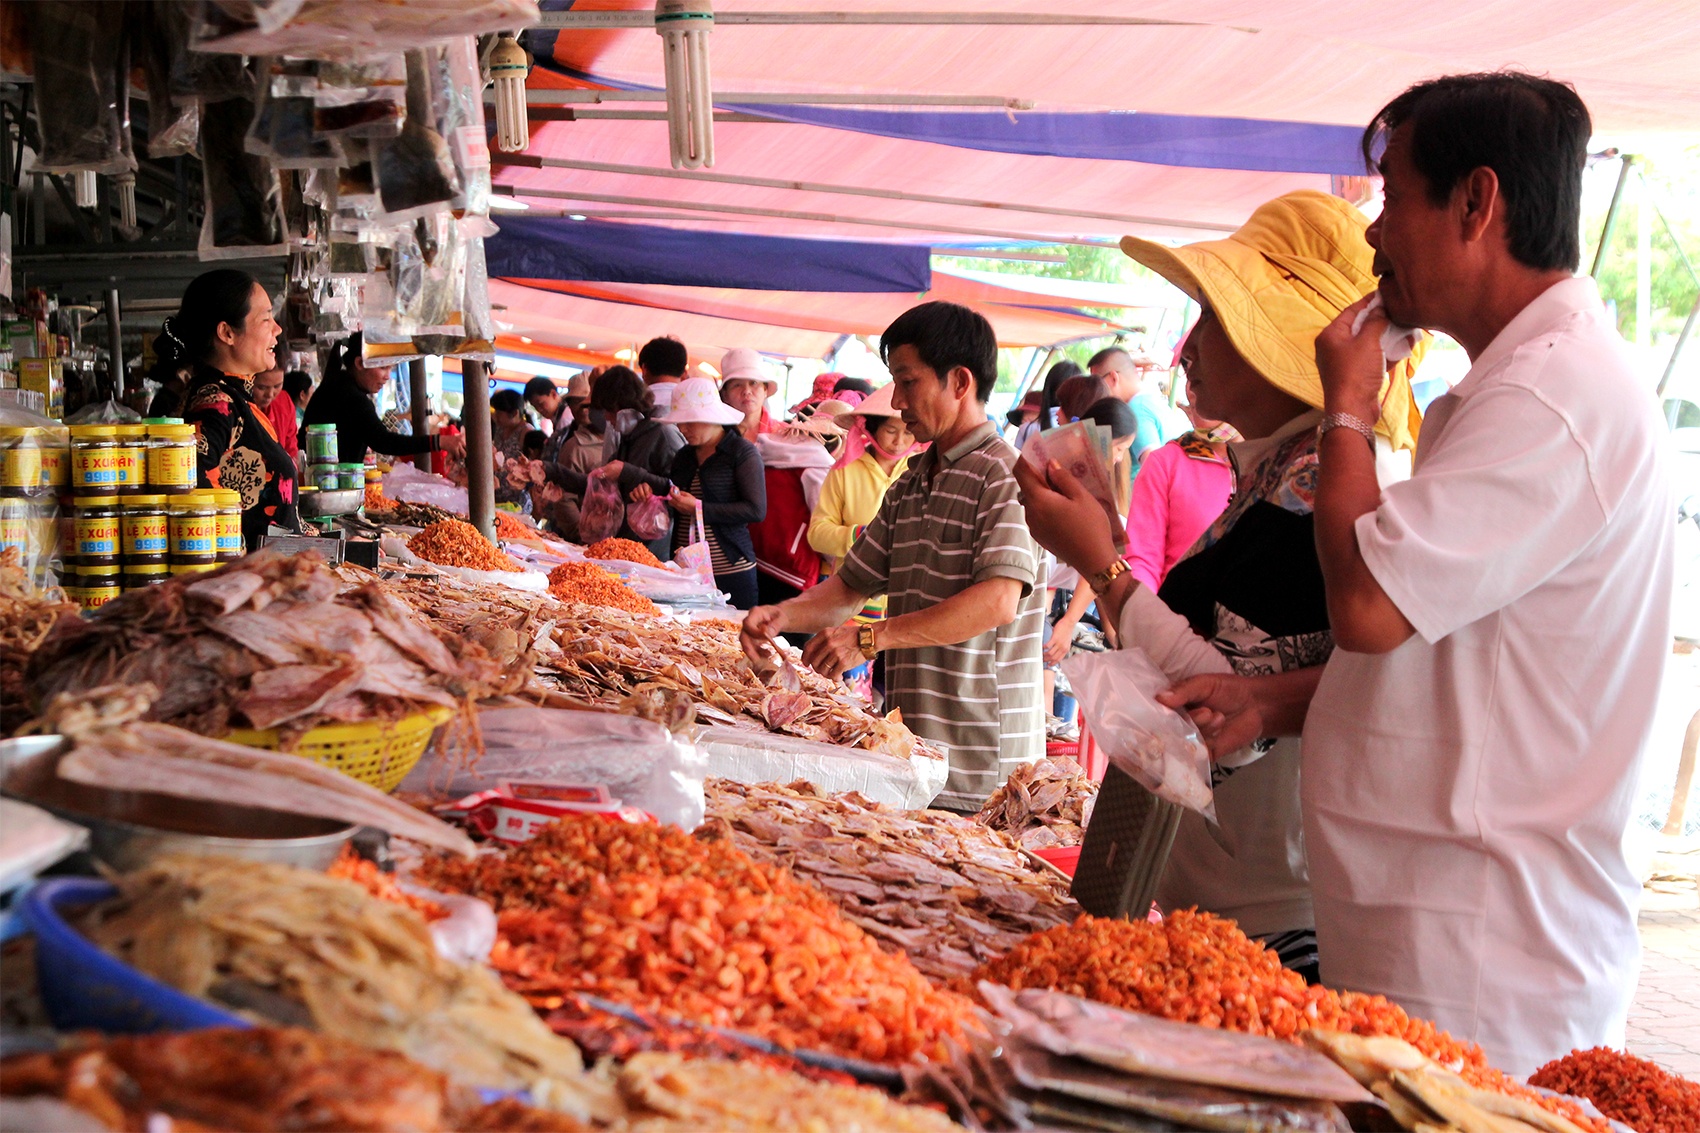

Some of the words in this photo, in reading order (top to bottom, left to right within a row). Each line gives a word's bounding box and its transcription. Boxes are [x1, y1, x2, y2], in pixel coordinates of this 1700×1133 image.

[84, 470, 116, 482] 9999
[143, 523, 167, 536] XUÂ
[81, 540, 114, 552] 9999
[134, 538, 167, 550] 9999
[179, 538, 211, 551] 9999
